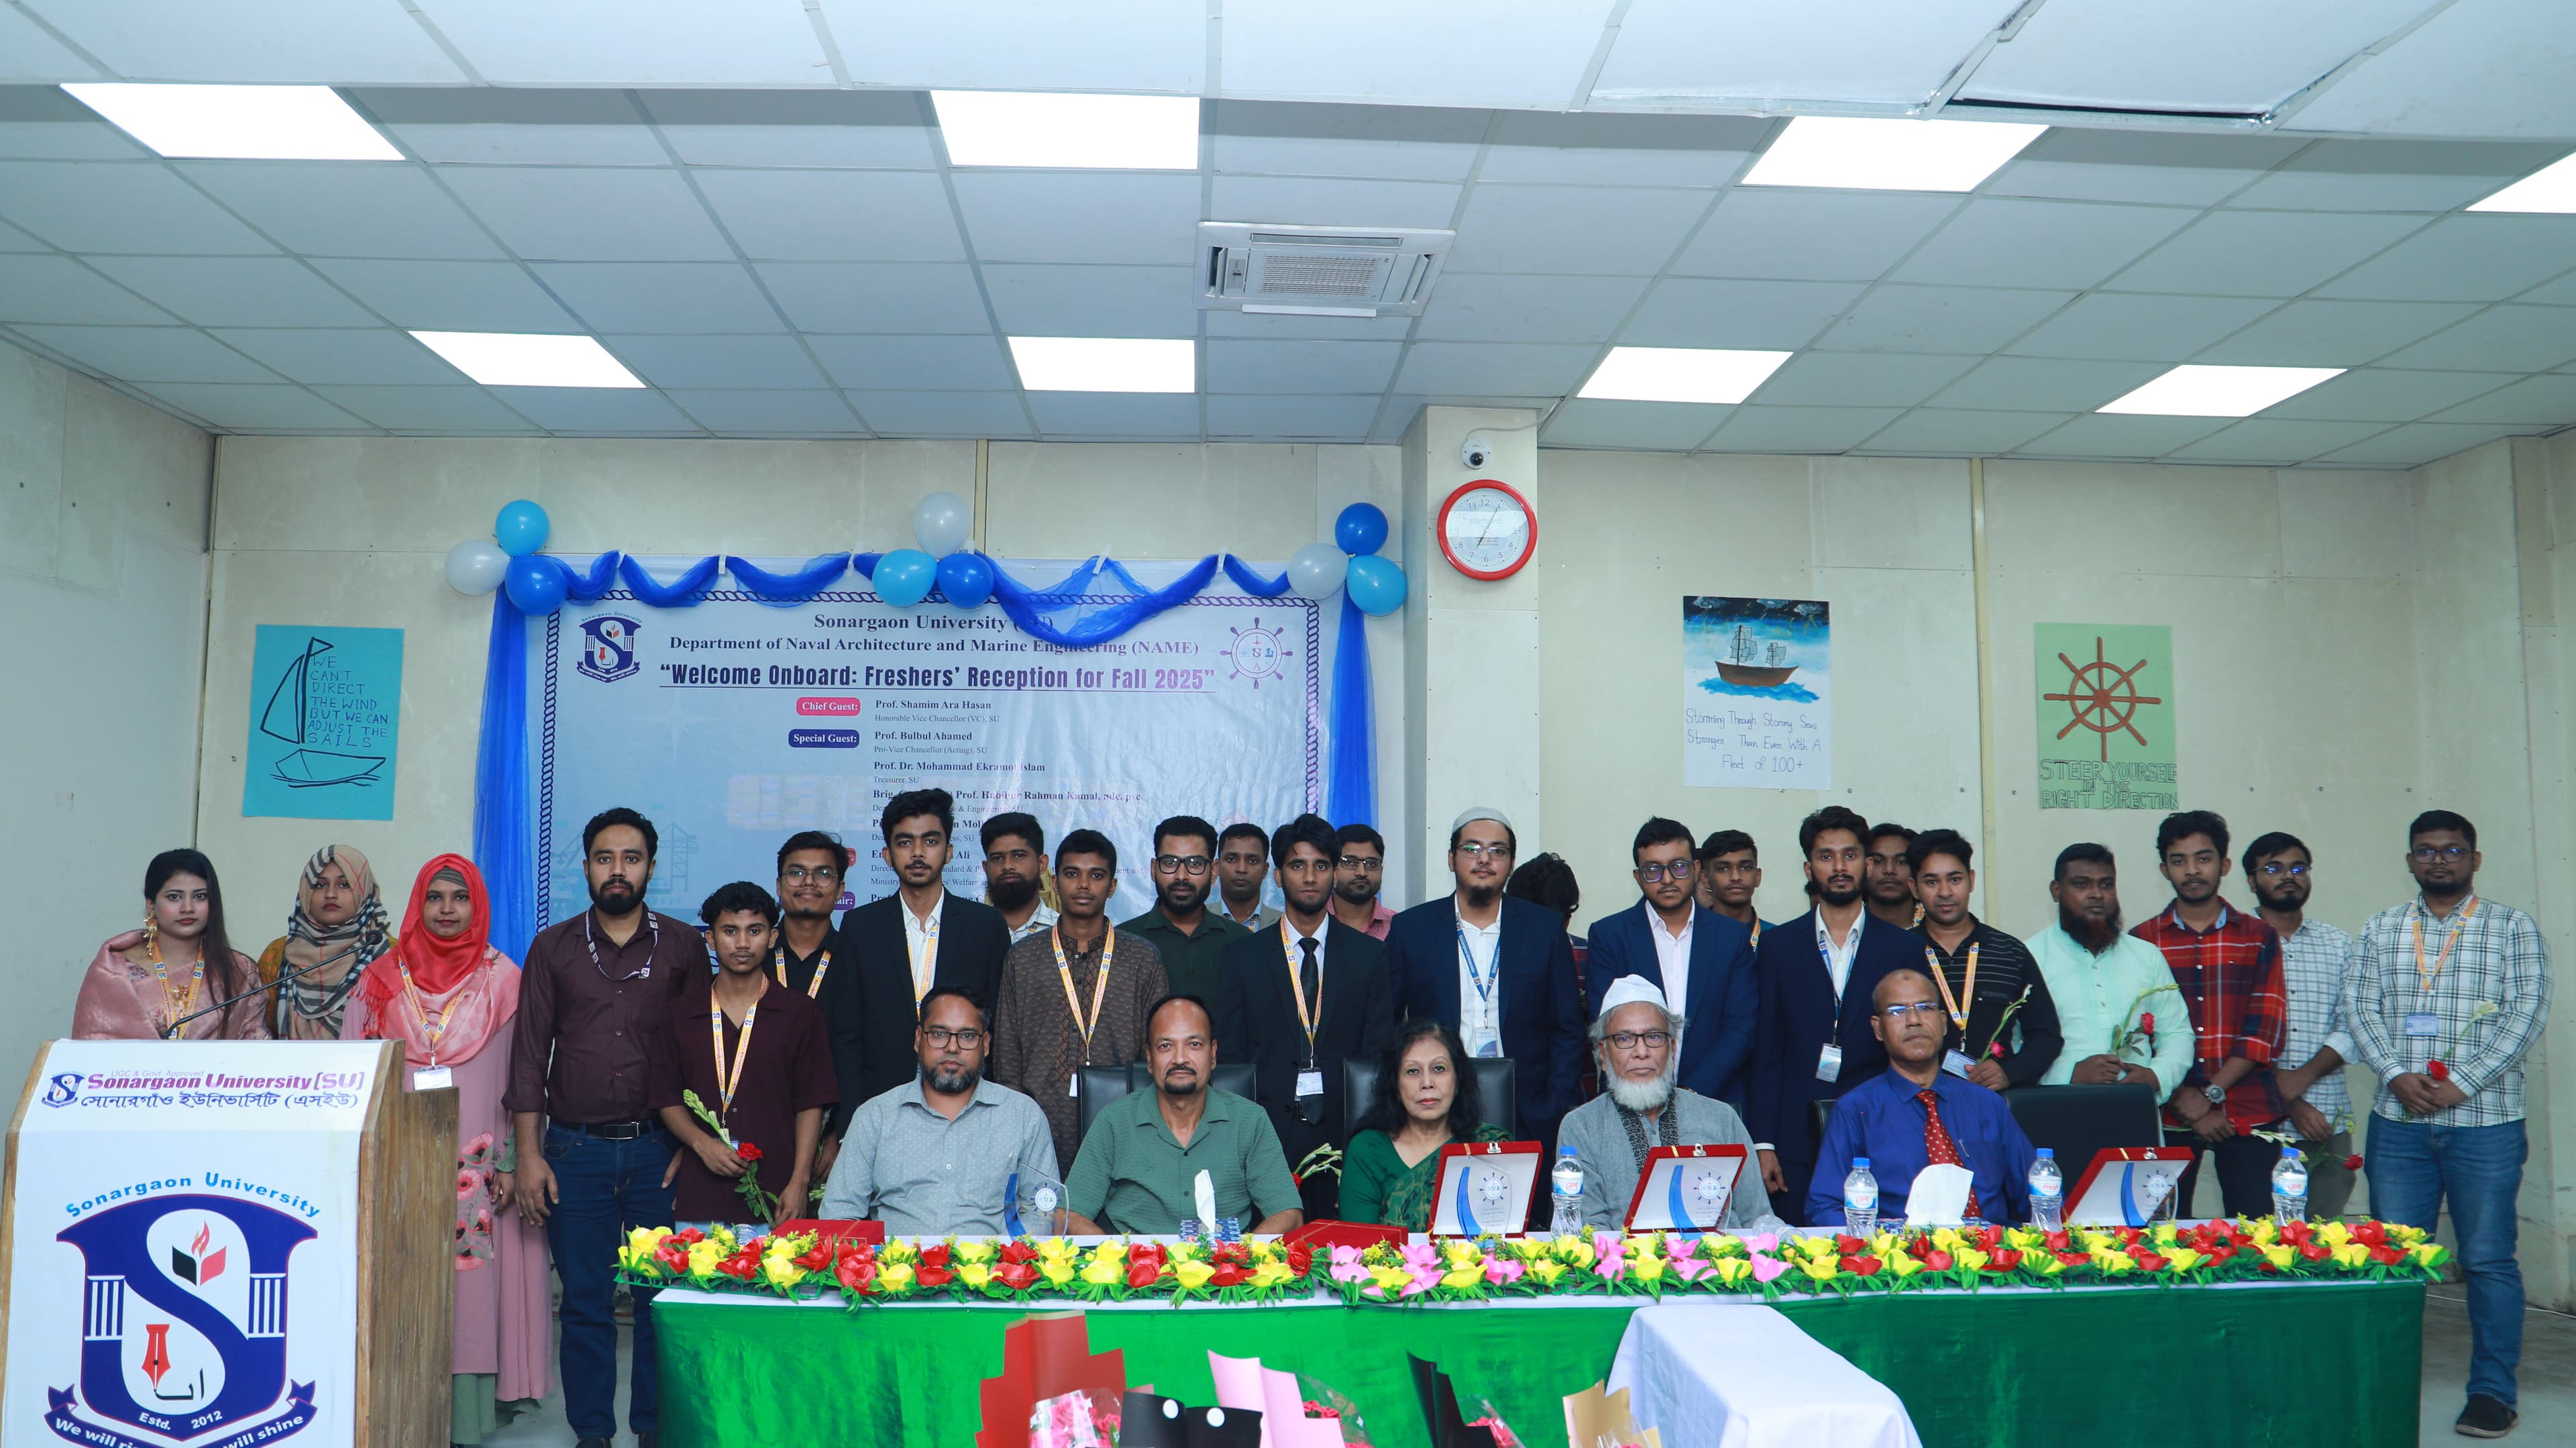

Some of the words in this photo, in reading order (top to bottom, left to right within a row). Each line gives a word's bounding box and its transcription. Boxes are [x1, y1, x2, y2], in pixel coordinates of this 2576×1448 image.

[814, 614, 909, 631] Sonargaon
[916, 615, 1008, 633] University
[670, 636, 762, 652] Department
[767, 637, 783, 650] of
[786, 637, 830, 650] Naval
[835, 638, 932, 652] Architecture
[936, 639, 965, 652] and
[971, 639, 1027, 652] Marine
[1131, 641, 1199, 656] (NAME)
[313, 656, 337, 668] WE
[310, 670, 352, 682] CAN'T
[659, 664, 761, 685] “Welcome
[769, 665, 857, 686] Onboard:
[865, 666, 961, 687] Freshers’
[968, 667, 1068, 691] Reception
[1076, 668, 1104, 688] for
[1112, 668, 1147, 689] Fall
[1155, 669, 1216, 690] 2025”
[312, 682, 366, 694] DIRECT
[311, 696, 337, 708] THE
[342, 698, 377, 711] WIND
[802, 701, 827, 711] Chief
[828, 703, 859, 711] Guest:
[875, 700, 898, 709] Prof.
[901, 700, 939, 709] Shamim
[941, 701, 959, 709] Ara
[962, 701, 991, 709] Hasan
[310, 708, 340, 719] BUT
[345, 713, 362, 723] WE
[366, 713, 388, 724] CAN
[929, 715, 966, 723] Chancellor
[967, 715, 987, 724] (VC),
[1686, 708, 1726, 729] Storming
[1728, 710, 1757, 729] Through
[1763, 713, 1793, 733] Stormy
[1799, 715, 1818, 729] Seas
[307, 720, 353, 734] ADJUST
[361, 726, 387, 737] THE
[875, 731, 897, 740] Prof.
[900, 731, 931, 740] Bulbul
[933, 731, 972, 741] Ahamed
[307, 732, 372, 747] SAILS
[794, 734, 825, 743] Special
[828, 734, 857, 743] Guest:
[1687, 729, 1726, 750] Stronger
[1738, 735, 1759, 748] Than
[1788, 737, 1809, 752] With
[1813, 738, 1821, 752] A
[906, 746, 943, 754] Chancellor
[944, 747, 975, 756] (Acting),
[873, 762, 896, 770] Prof.
[899, 762, 914, 770] Dr.
[916, 762, 973, 771] Mohammad
[1722, 754, 1745, 771] Fleet
[1755, 756, 1766, 771] of
[1772, 757, 1804, 772] 100+
[2040, 758, 2104, 781] STEER
[2108, 762, 2178, 784] YOURSELF
[873, 776, 906, 784] Treasurer,
[2083, 779, 2096, 792] IN
[2104, 780, 2131, 792] THE
[873, 790, 894, 800] Brig
[956, 790, 979, 799] Prof.
[1024, 791, 1063, 800] Rahman
[1067, 792, 1101, 801] Kamal,
[1126, 794, 1141, 802] psc
[2041, 790, 2096, 809] RIGHT
[2103, 790, 2179, 810] DIRECTION
[956, 850, 970, 860] Ali
[871, 878, 900, 886] Ministry
[166, 1070, 205, 1078] Approved
[88, 1074, 201, 1090] Sonargaon
[205, 1074, 313, 1090] University
[81, 1092, 173, 1108] সোনারগাঁও
[178, 1091, 281, 1108] ইউনিভার্সিটি
[284, 1091, 358, 1108] (এসইউ)
[66, 1175, 192, 1218] Sonargaon
[205, 1172, 321, 1219] University
[138, 1412, 171, 1431] Estd.
[191, 1410, 223, 1429] 2012
[56, 1417, 82, 1436] We
[85, 1430, 117, 1447] will
[258, 1415, 304, 1440] shine
